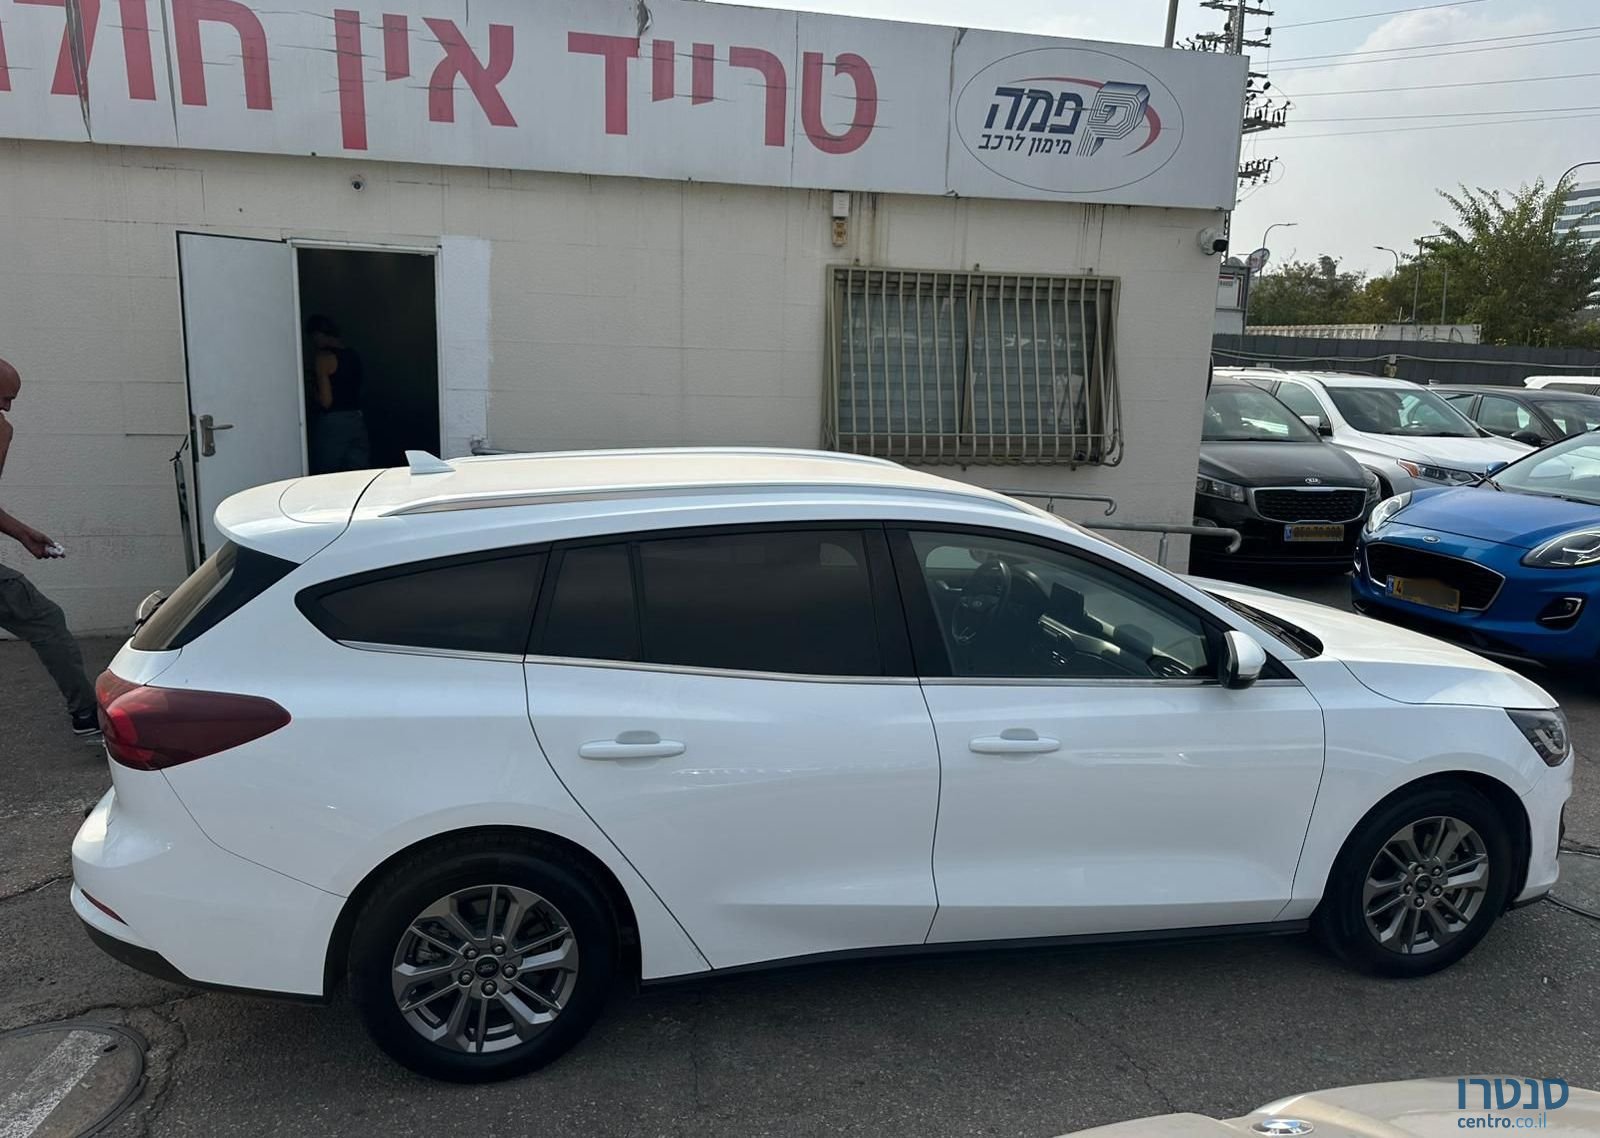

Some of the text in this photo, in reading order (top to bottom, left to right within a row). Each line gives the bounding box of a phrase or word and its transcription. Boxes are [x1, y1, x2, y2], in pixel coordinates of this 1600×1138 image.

[333, 9, 518, 151] אין
[567, 31, 878, 155] טרייד
[984, 86, 1084, 135] פמה
[977, 132, 1072, 156] מימון לרכב
